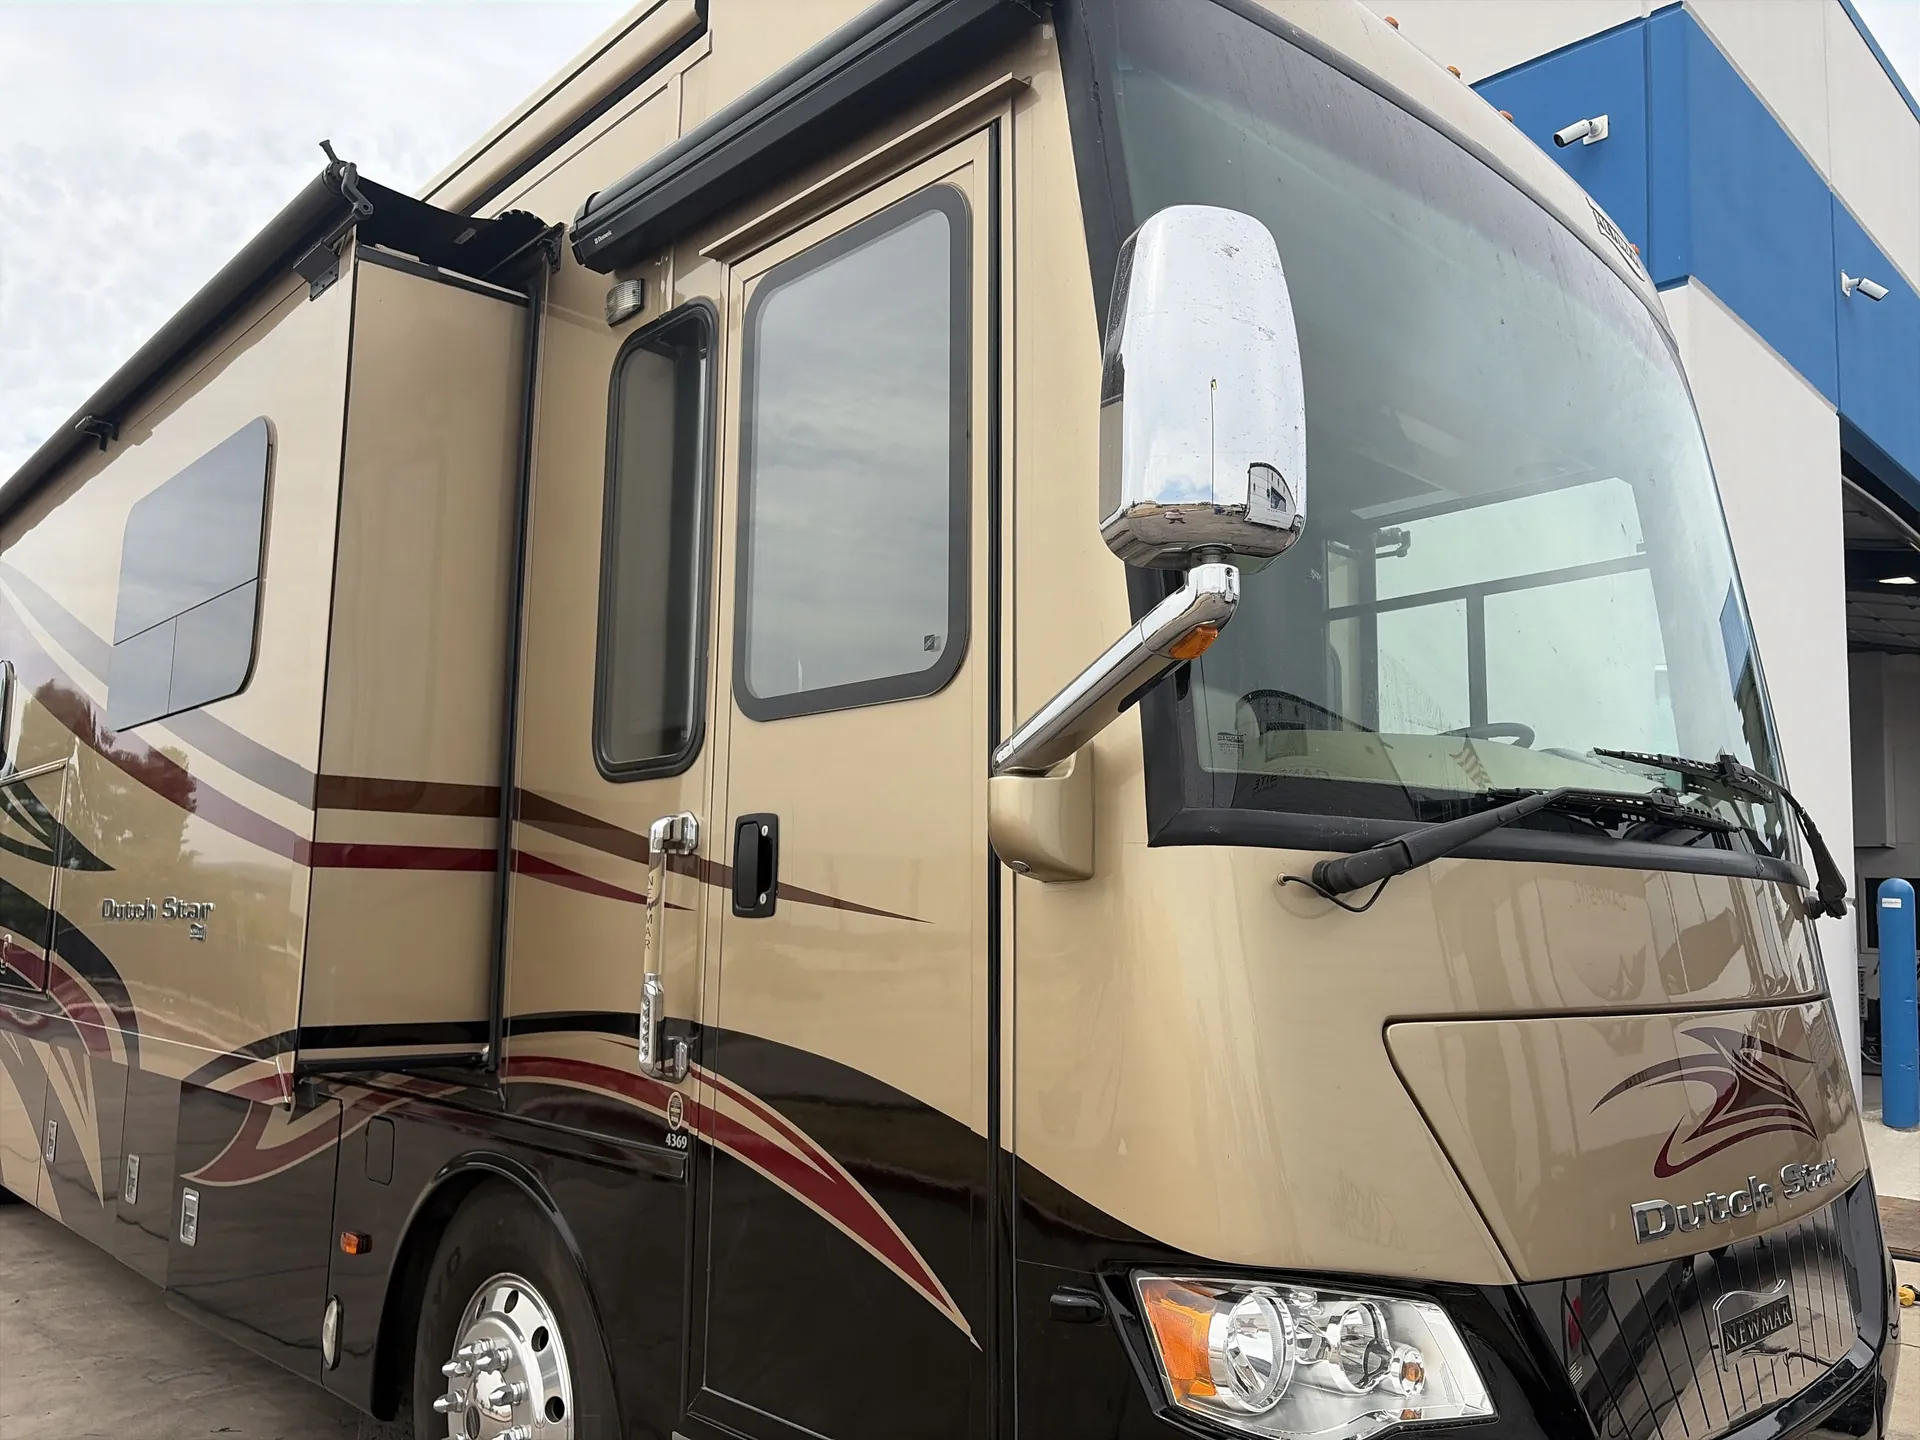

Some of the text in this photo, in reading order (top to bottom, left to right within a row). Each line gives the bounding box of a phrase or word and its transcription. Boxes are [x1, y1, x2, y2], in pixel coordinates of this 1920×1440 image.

[101, 896, 216, 921] Dutch Star
[665, 1132, 688, 1149] 4369
[1630, 1158, 1838, 1244] Dutch Star
[1723, 1301, 1792, 1350] NEWMAR
